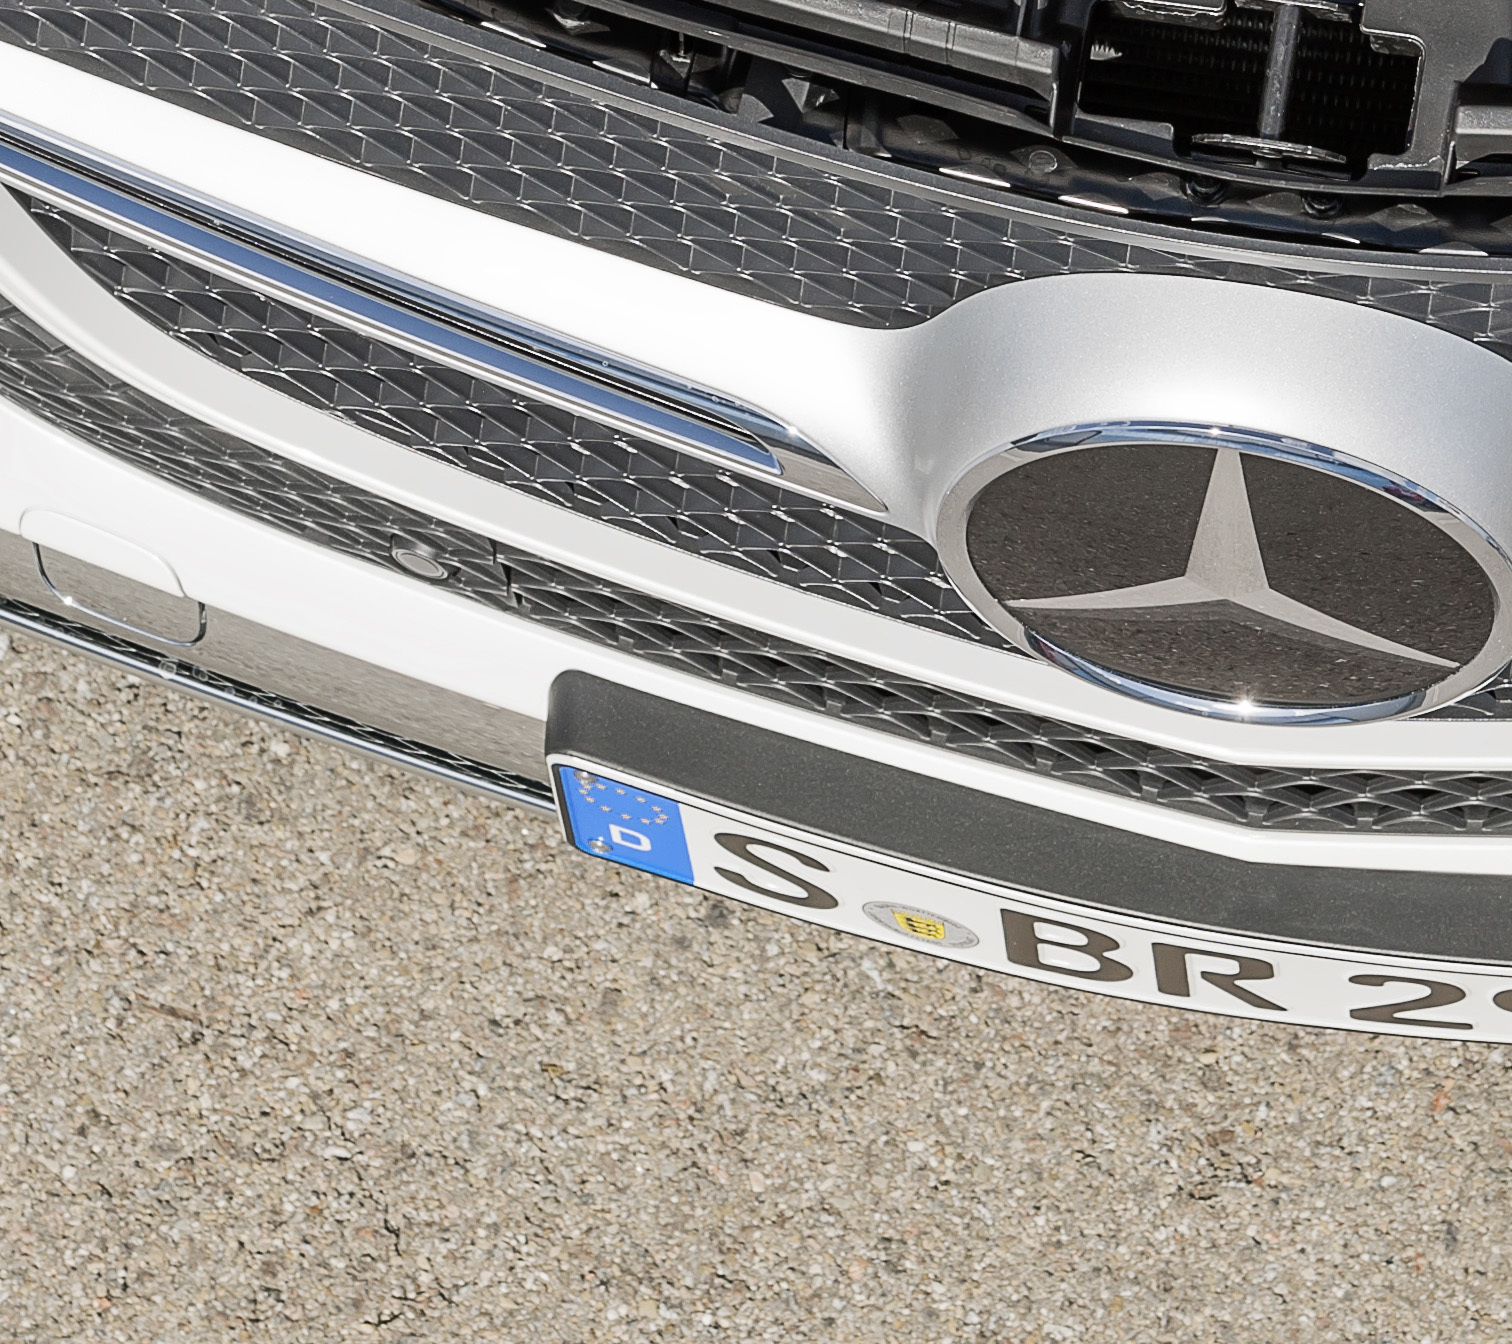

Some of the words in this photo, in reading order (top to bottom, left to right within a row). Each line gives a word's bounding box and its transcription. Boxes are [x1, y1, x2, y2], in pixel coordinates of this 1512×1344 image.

[609, 824, 651, 852] D
[714, 832, 839, 909] S
[1000, 908, 1289, 1012] BR
